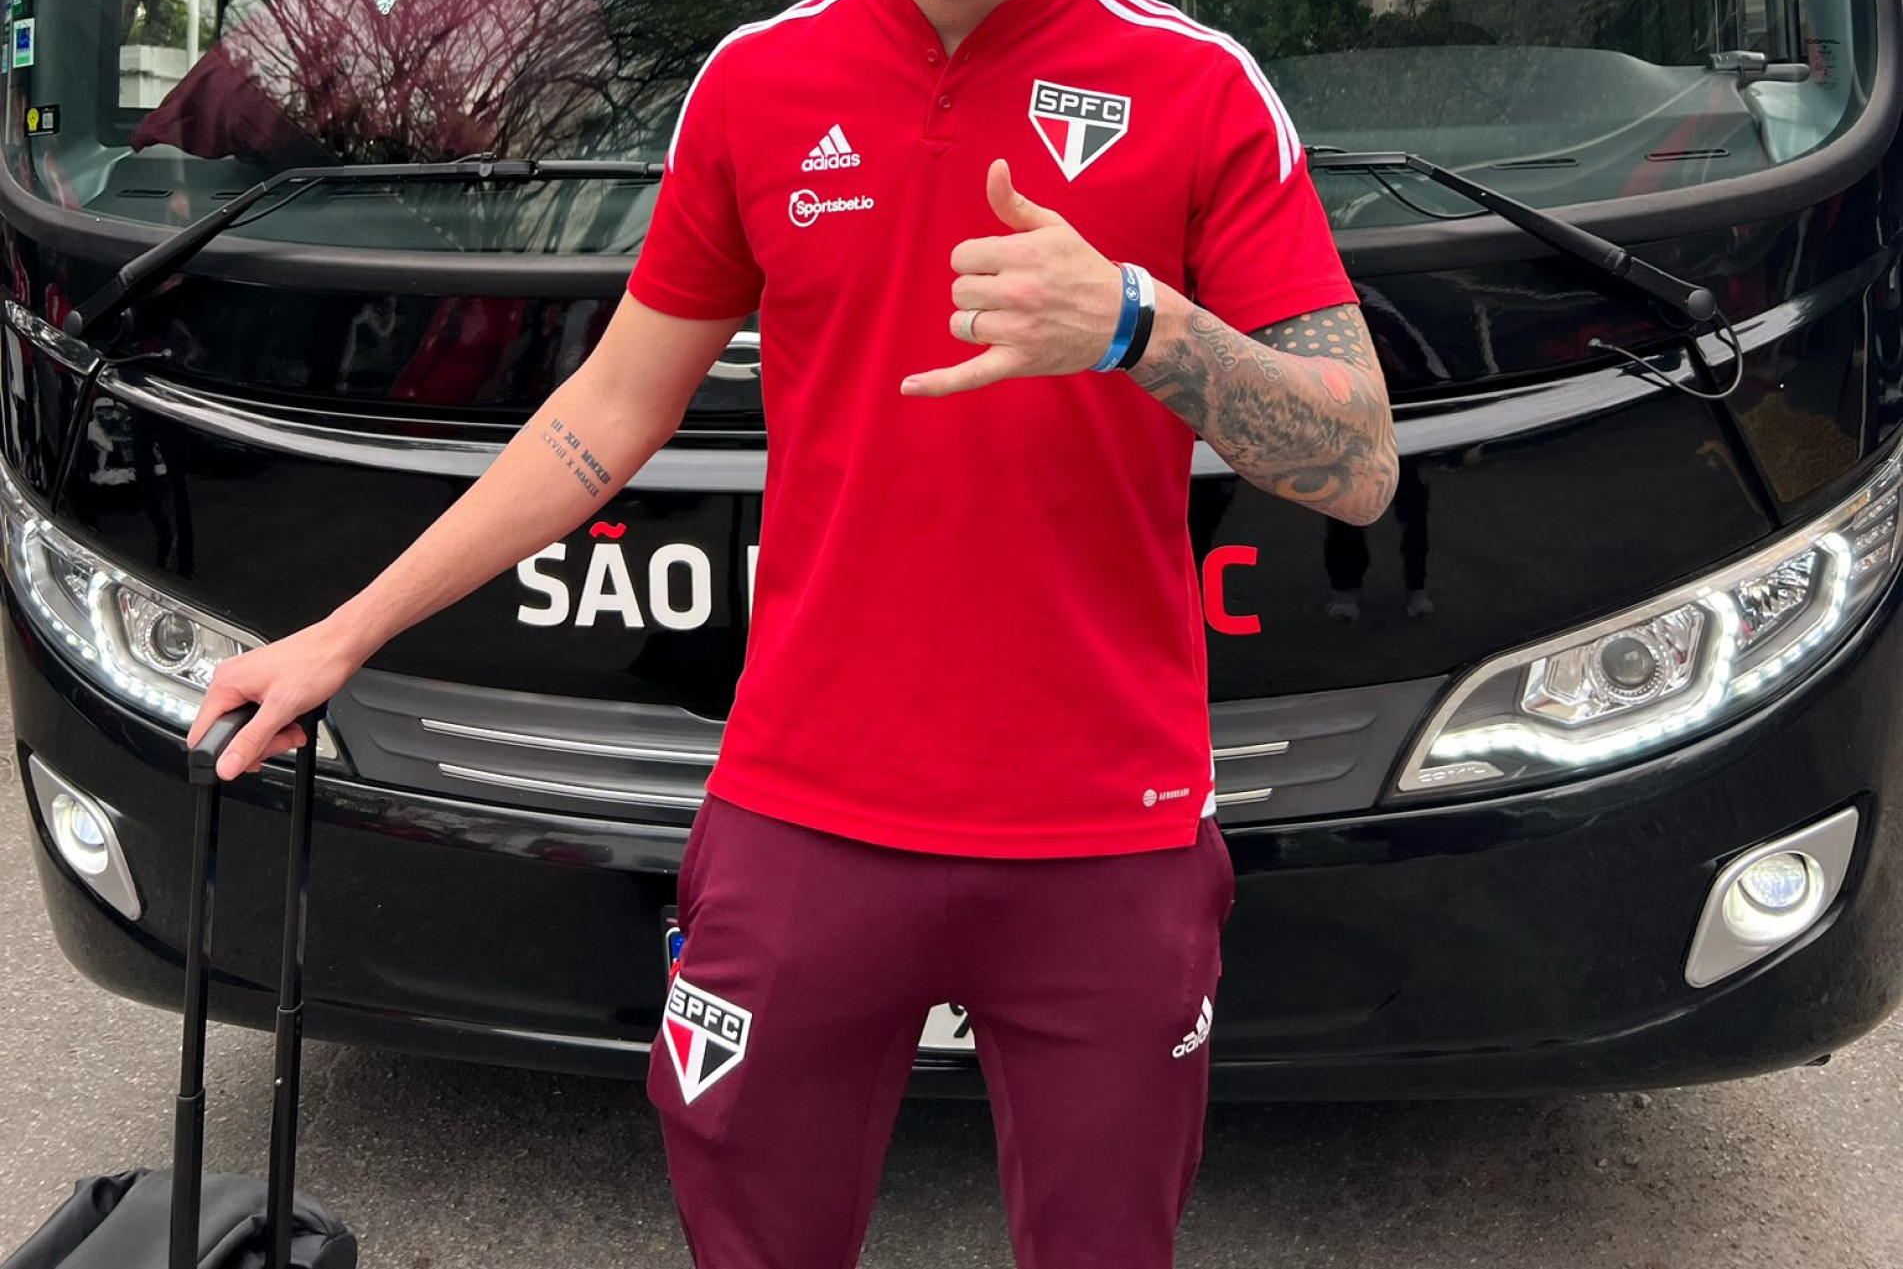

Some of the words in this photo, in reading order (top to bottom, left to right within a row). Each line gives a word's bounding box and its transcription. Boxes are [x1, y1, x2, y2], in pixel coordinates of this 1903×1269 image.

[1037, 89, 1122, 121] SPFC
[801, 153, 861, 172] adidas
[796, 195, 875, 218] Sportsbet.io
[517, 521, 712, 630] SÃO
[669, 988, 741, 1041] SPFC
